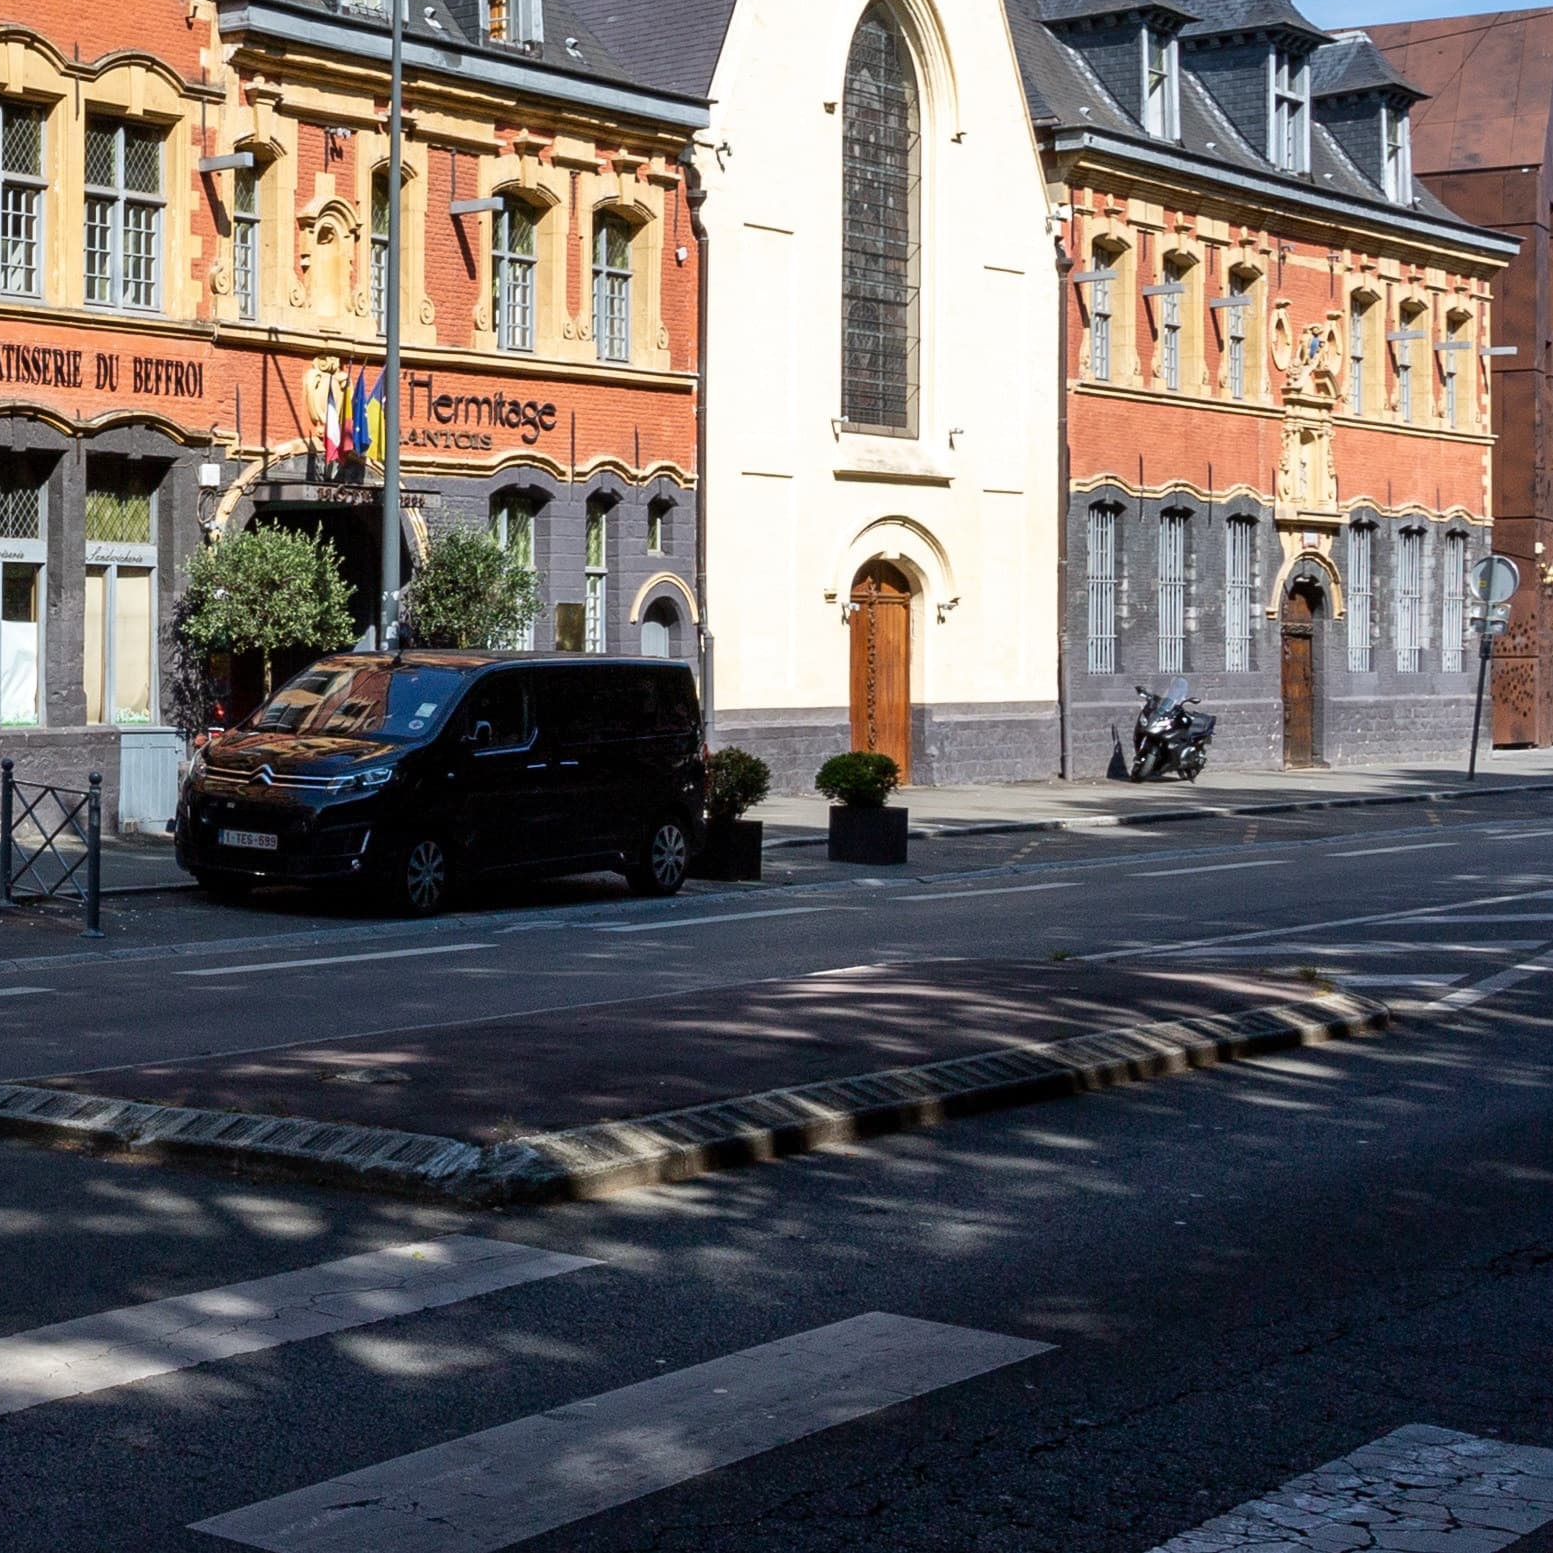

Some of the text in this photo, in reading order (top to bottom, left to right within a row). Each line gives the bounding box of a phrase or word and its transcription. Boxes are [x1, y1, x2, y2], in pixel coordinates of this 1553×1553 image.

[94, 352, 120, 392] DU
[132, 356, 203, 398] BEFFROI
[402, 371, 558, 445] 'Hermitage
[399, 428, 493, 451] ANTOIS
